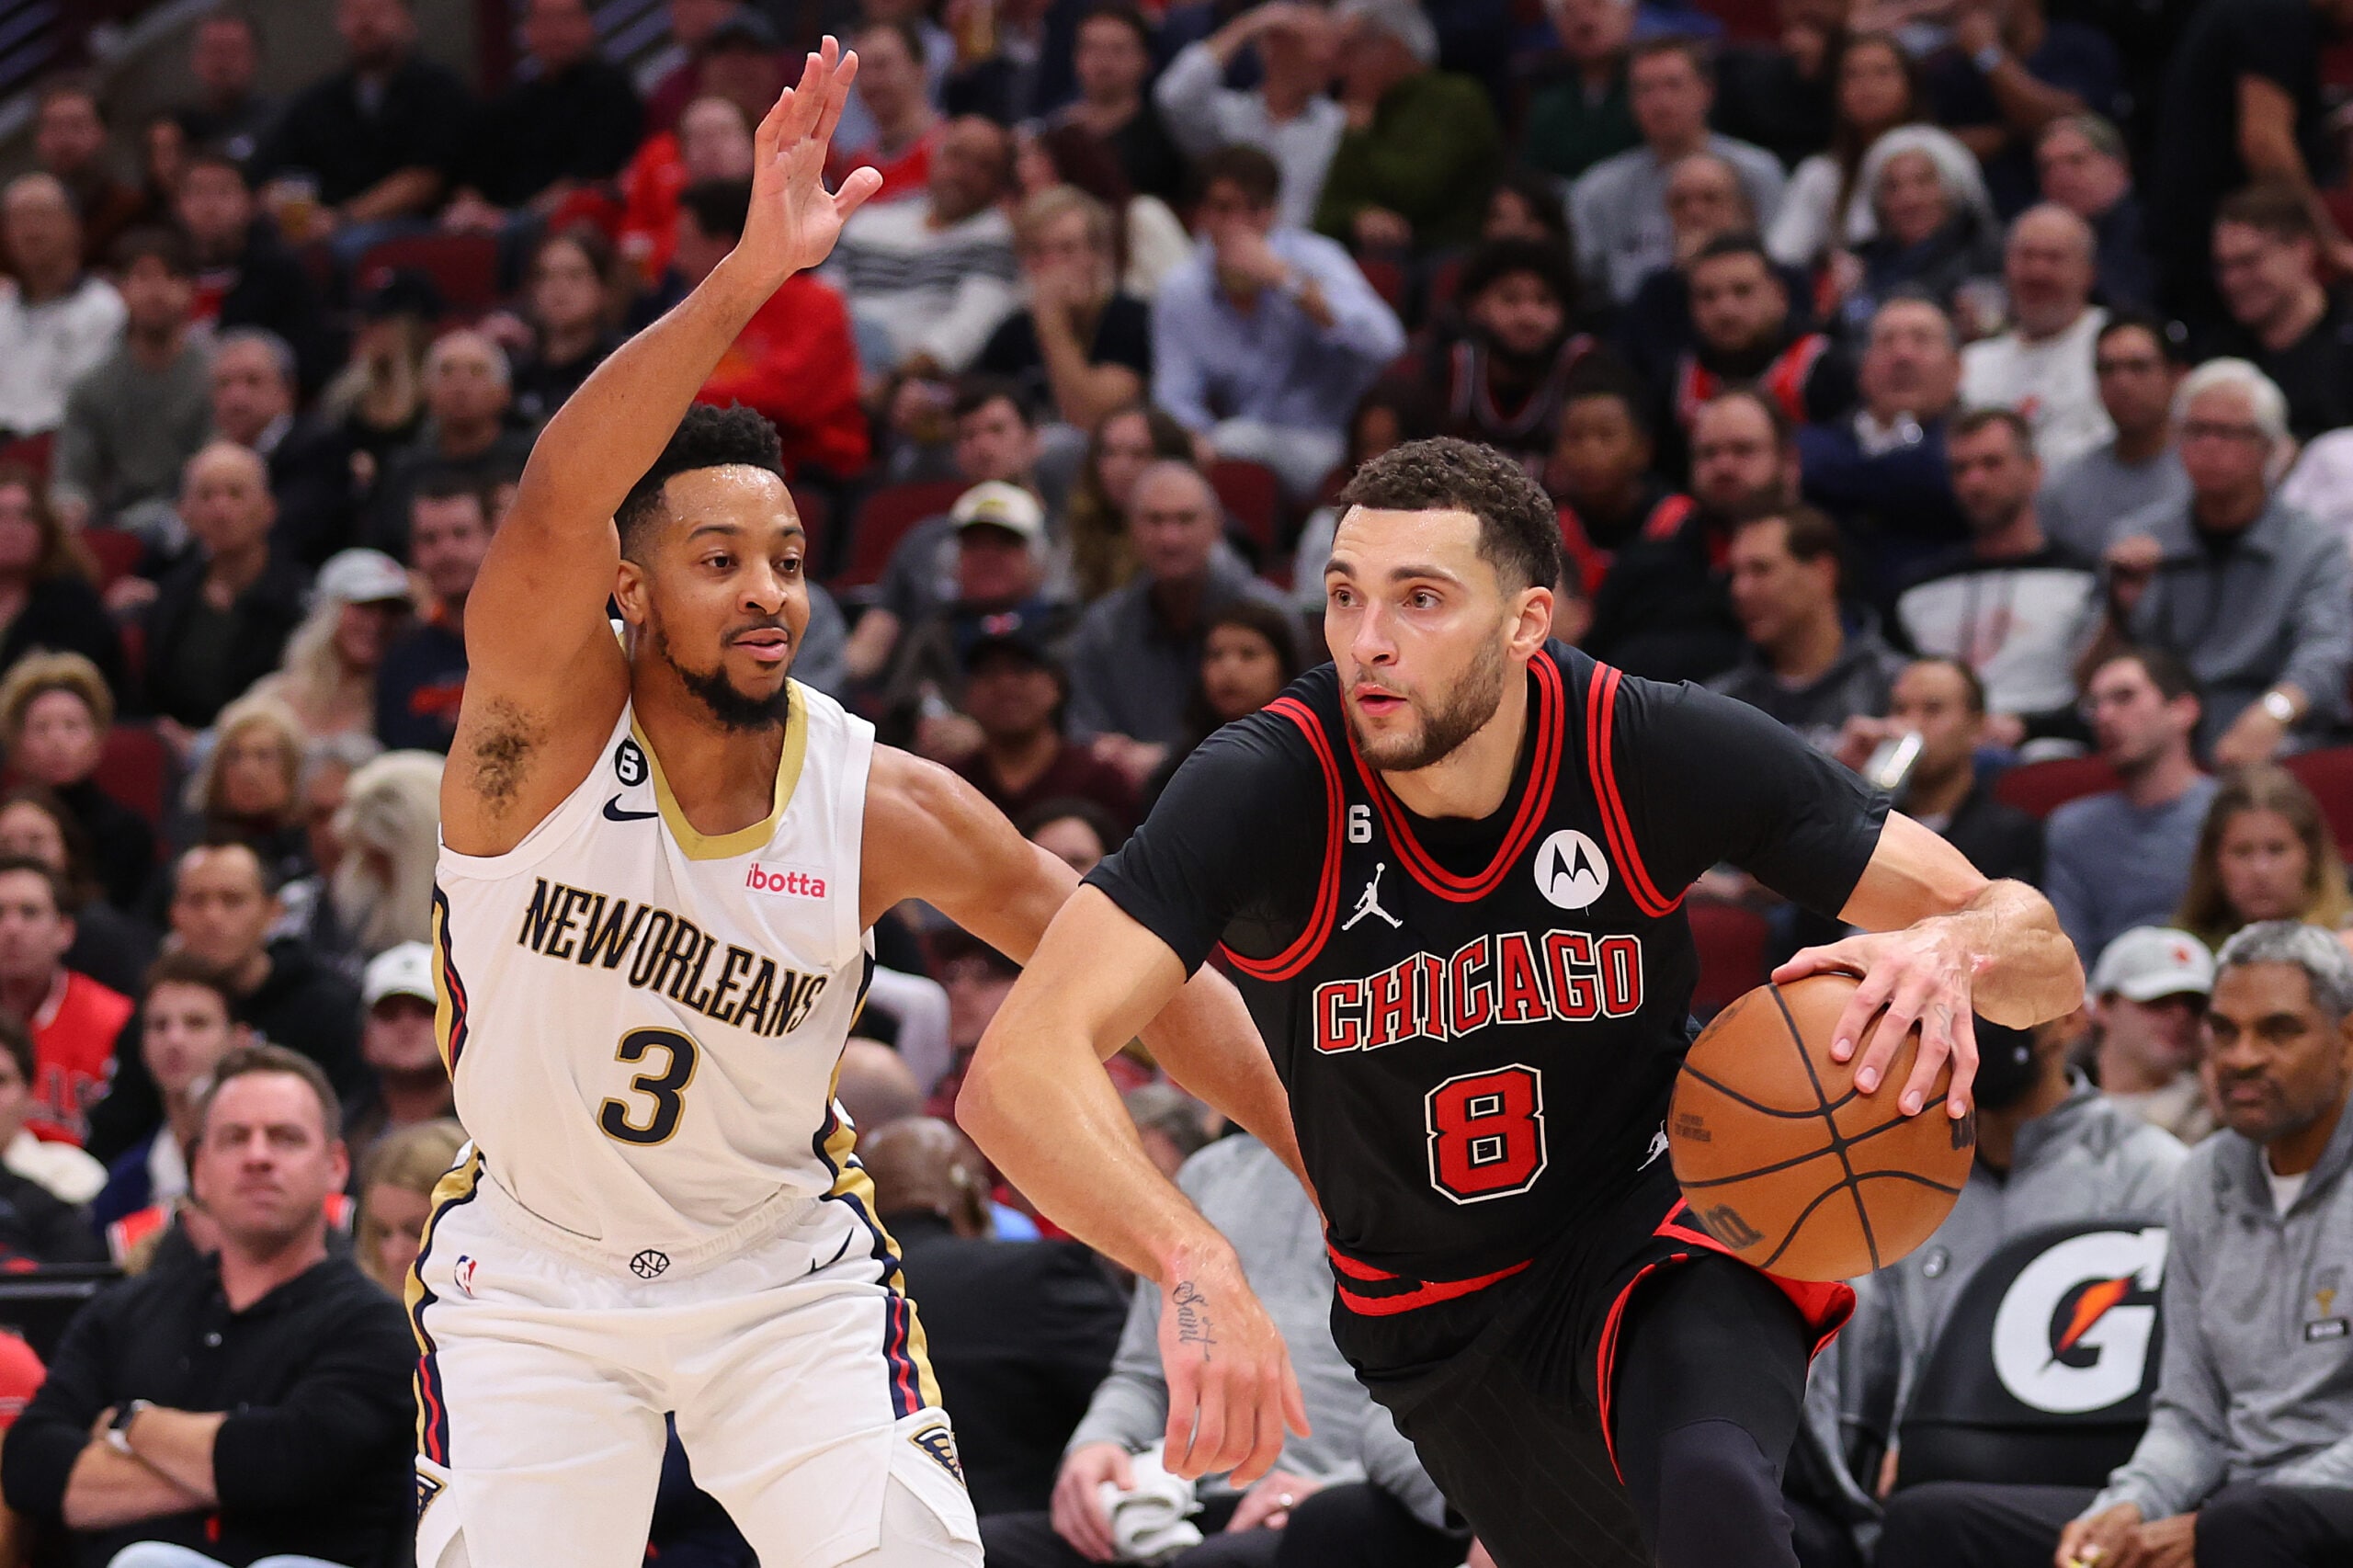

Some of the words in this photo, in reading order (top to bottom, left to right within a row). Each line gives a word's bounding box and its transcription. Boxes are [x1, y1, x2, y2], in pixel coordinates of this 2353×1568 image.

[619, 745, 639, 781] 6
[1348, 804, 1371, 843] 6
[746, 863, 825, 898] ibotta
[1313, 928, 1643, 1055] CHICAGO
[597, 1026, 700, 1147] 3
[1425, 1062, 1548, 1205] 8
[1173, 1280, 1217, 1361] Saint
[1991, 1227, 2170, 1415] G
